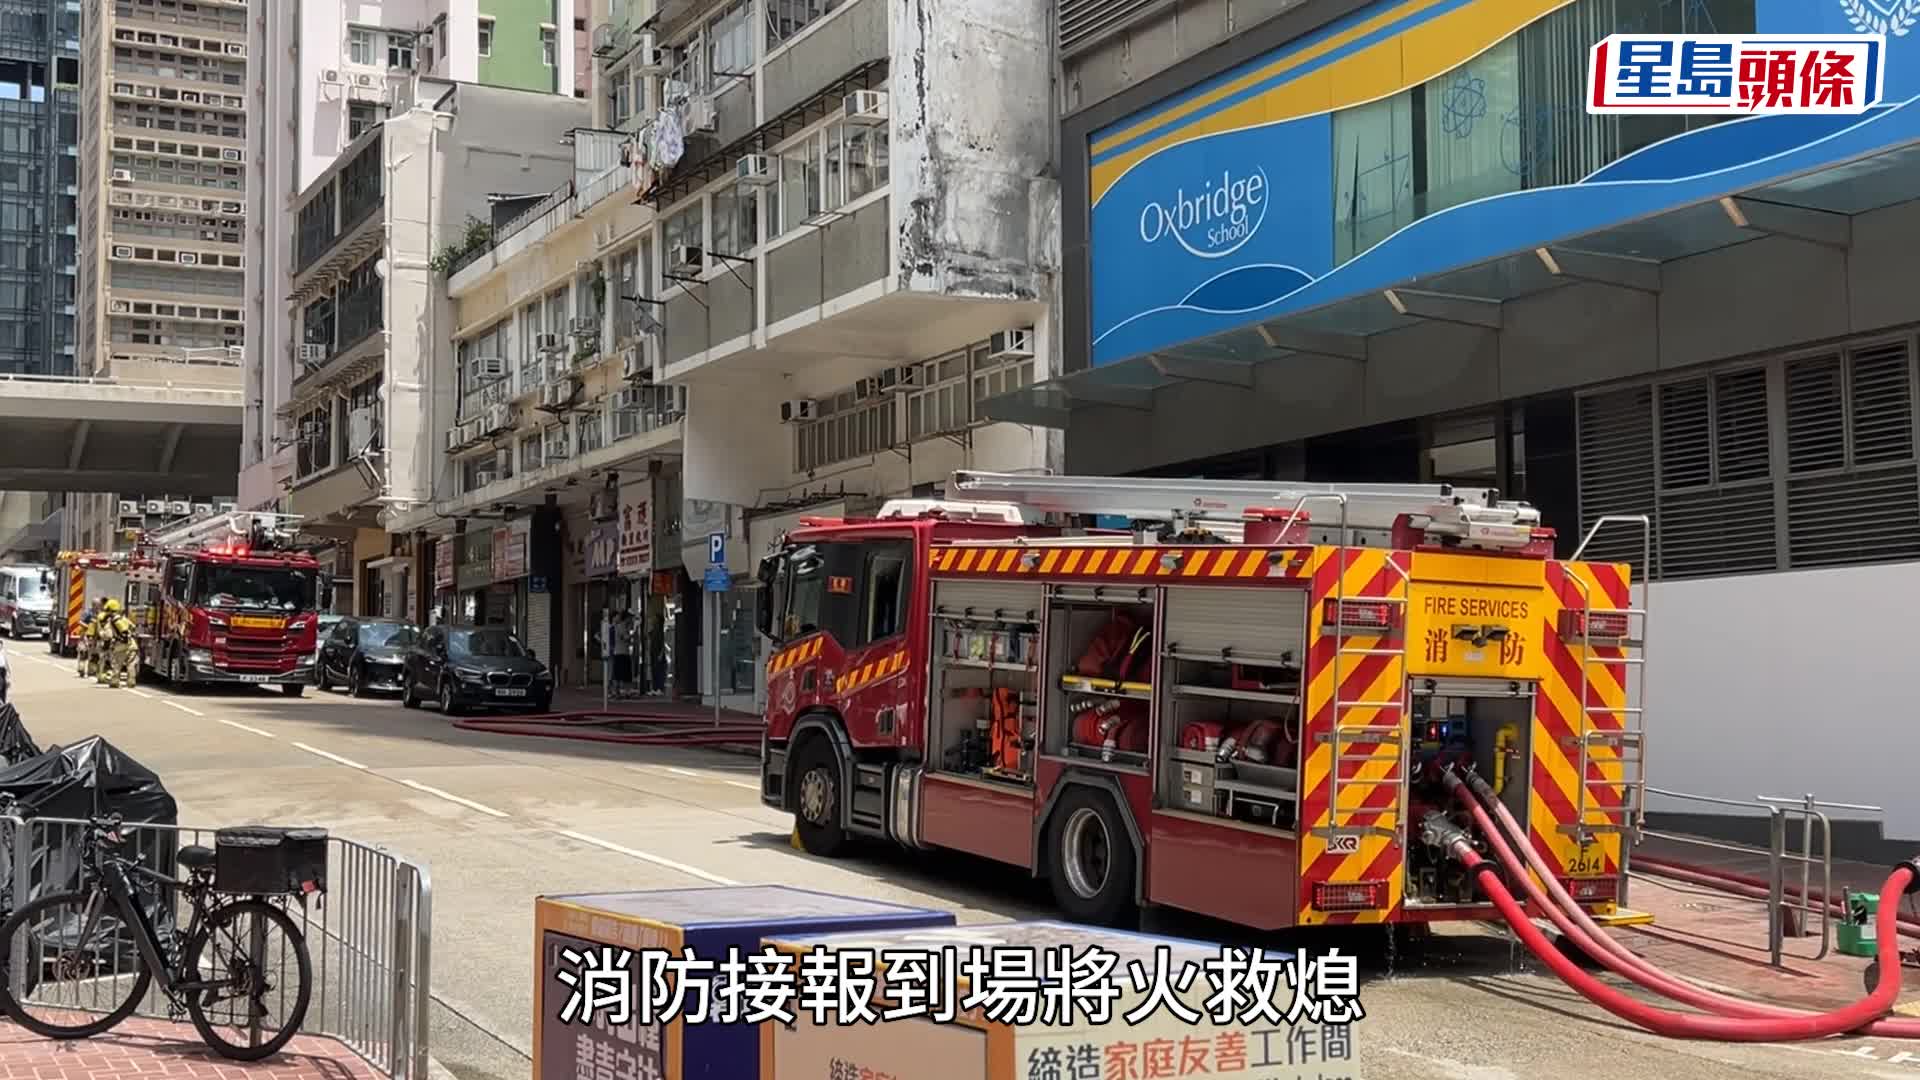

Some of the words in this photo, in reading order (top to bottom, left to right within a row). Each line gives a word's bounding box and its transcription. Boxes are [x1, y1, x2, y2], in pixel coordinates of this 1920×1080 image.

[1140, 170, 1263, 243] Oxbridge
[1207, 215, 1249, 248] School
[711, 535, 722, 562] P
[1424, 596, 1456, 616] FIRE
[1459, 597, 1529, 619] SERVICES
[1424, 627, 1449, 664] 消
[1499, 631, 1526, 666] 防
[1568, 857, 1600, 873] 2614
[1027, 1025, 1352, 1080] 締造家庭友善工作間
